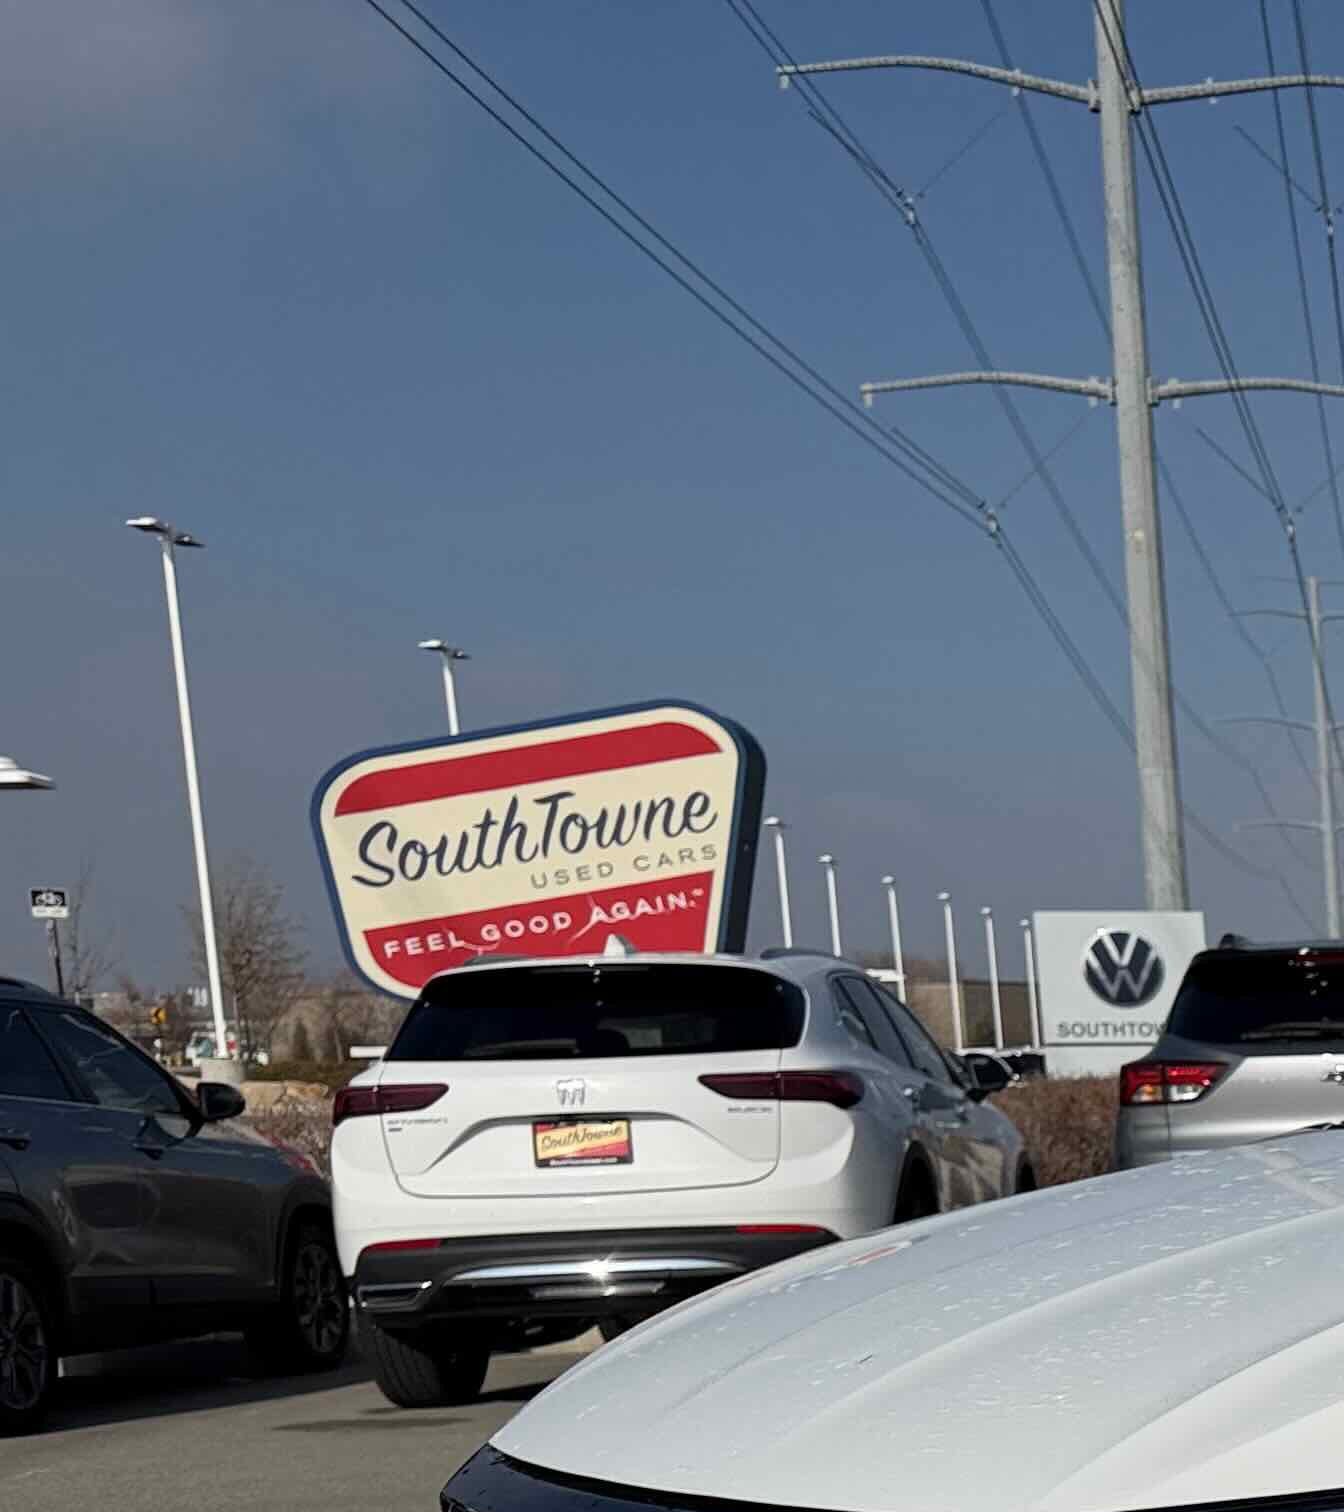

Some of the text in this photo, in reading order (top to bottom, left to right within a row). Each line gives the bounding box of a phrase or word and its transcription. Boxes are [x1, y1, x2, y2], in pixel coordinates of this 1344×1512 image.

[352, 790, 718, 888] SouthTowne
[530, 844, 717, 889] USED CARS
[383, 929, 465, 959] FEEL
[480, 910, 573, 942] GOOD
